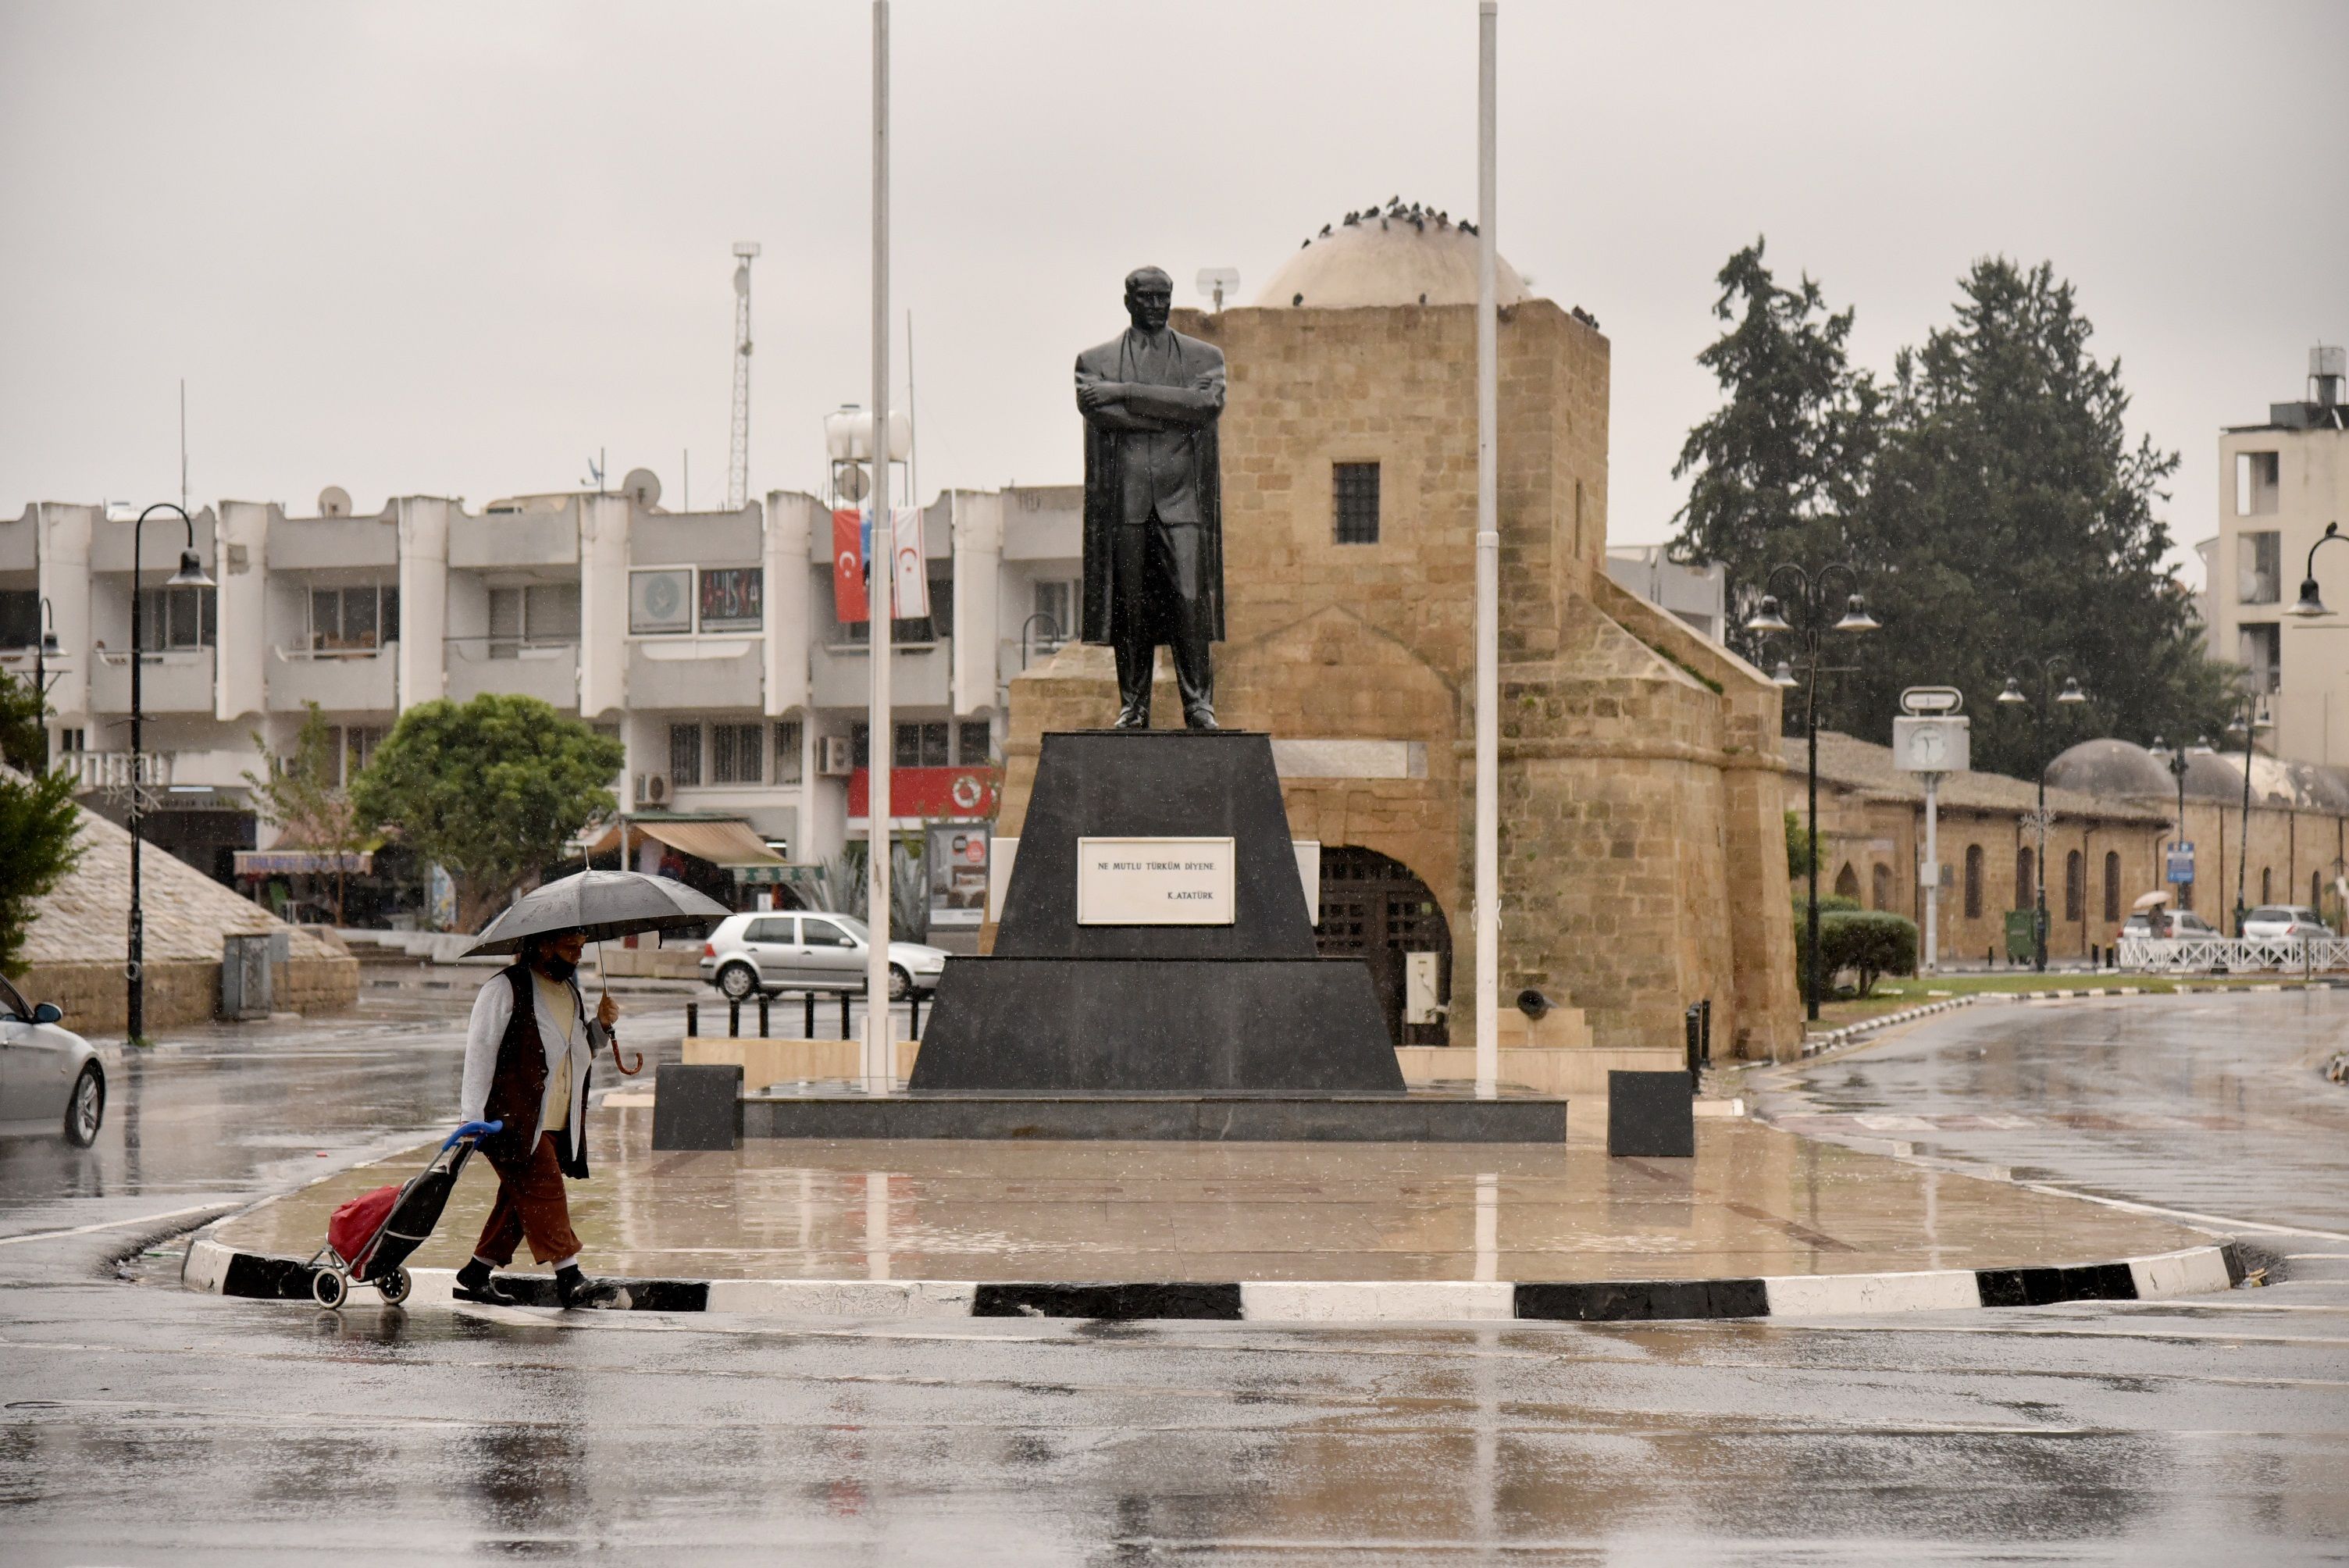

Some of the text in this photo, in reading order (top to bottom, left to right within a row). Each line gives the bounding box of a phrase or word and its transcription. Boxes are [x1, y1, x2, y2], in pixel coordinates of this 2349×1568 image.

[1098, 862, 1109, 871] NE
[1113, 862, 1142, 871] MUTLU
[1146, 861, 1180, 871] TÜRKÜM
